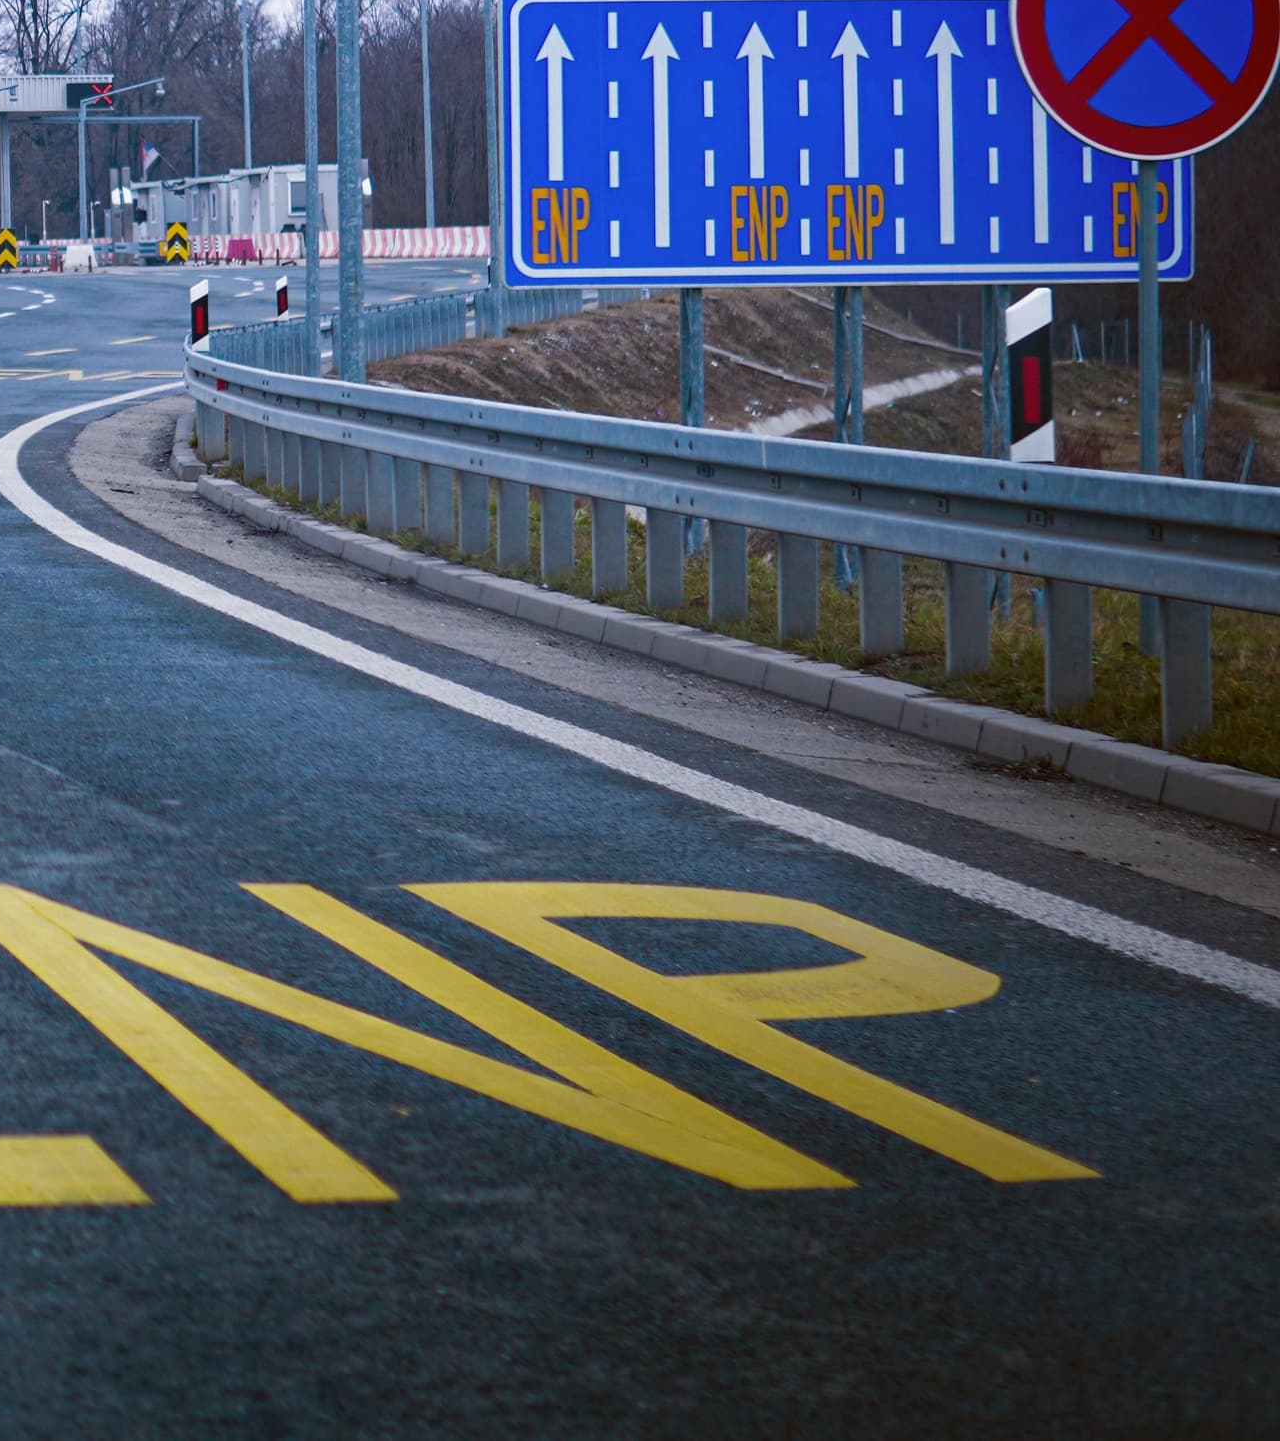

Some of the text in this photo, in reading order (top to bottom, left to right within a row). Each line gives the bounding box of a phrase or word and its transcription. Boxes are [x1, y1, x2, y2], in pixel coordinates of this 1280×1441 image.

[531, 187, 590, 264] ENP
[730, 185, 789, 262] ENP
[827, 184, 885, 261] ENP
